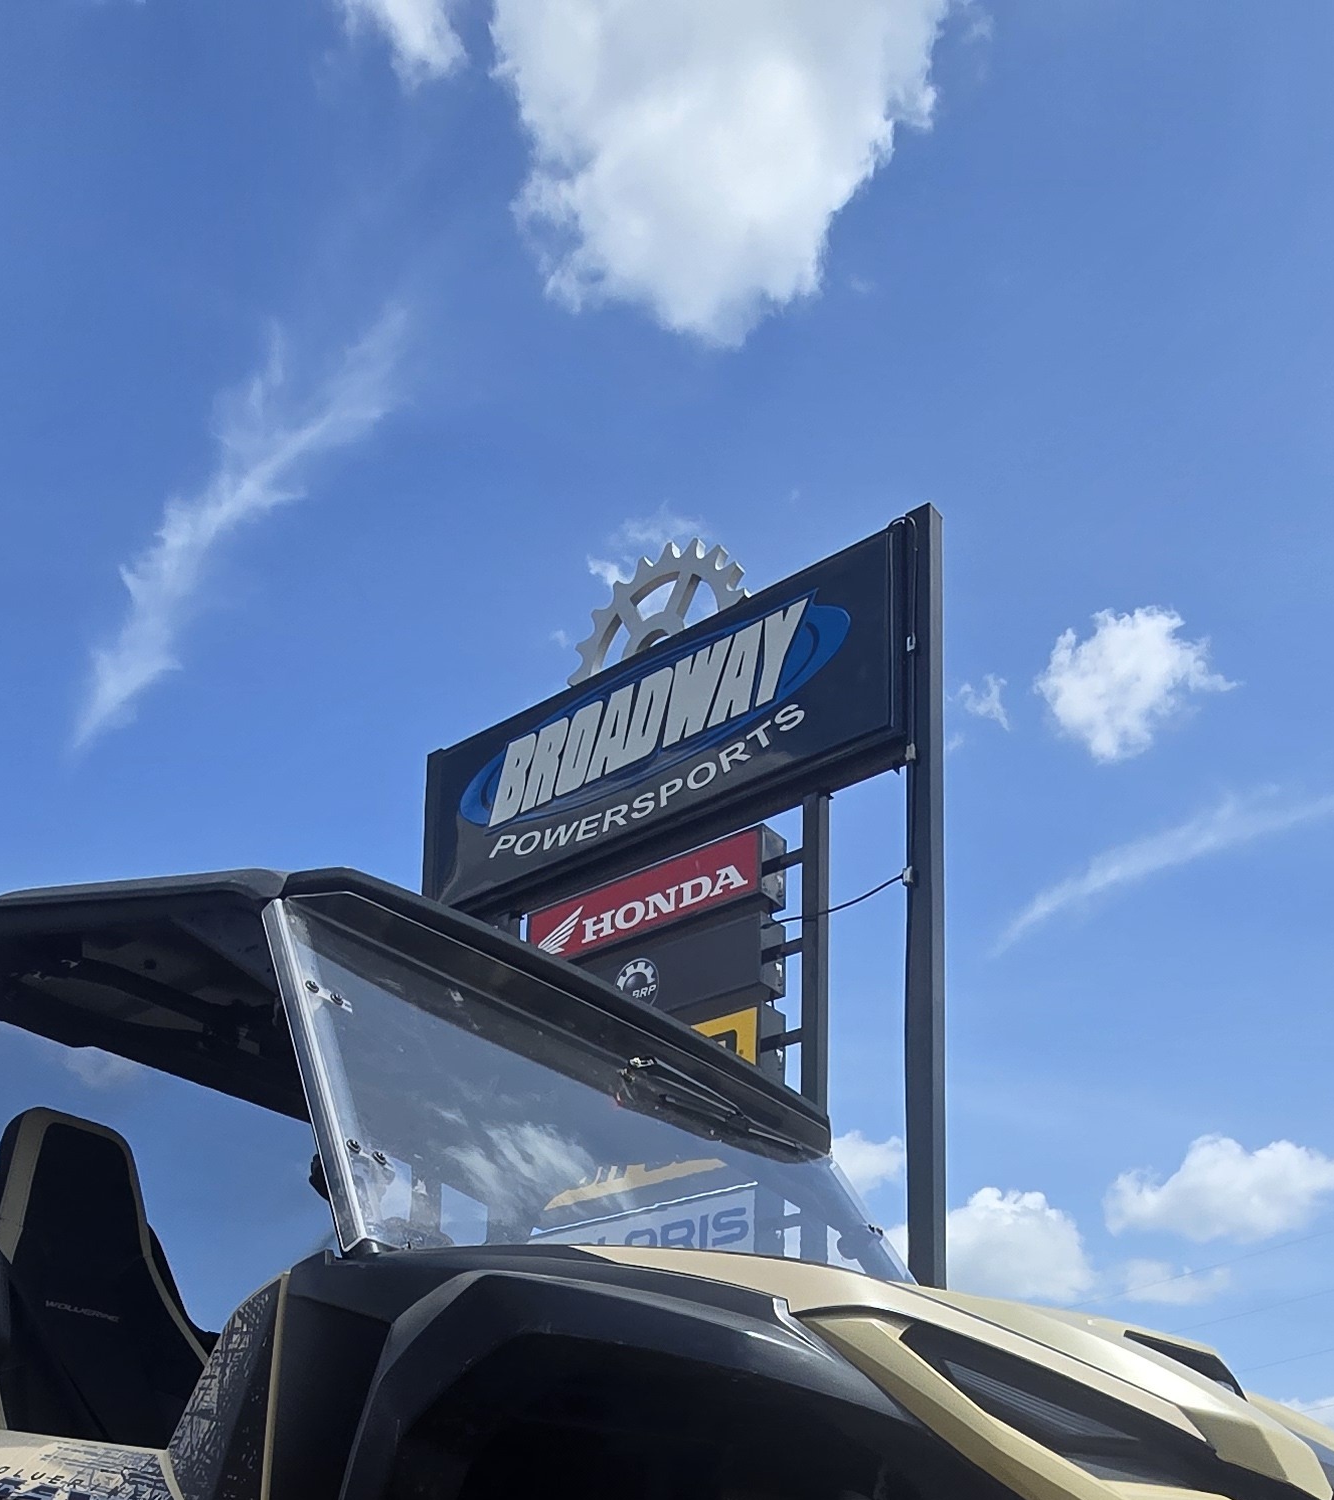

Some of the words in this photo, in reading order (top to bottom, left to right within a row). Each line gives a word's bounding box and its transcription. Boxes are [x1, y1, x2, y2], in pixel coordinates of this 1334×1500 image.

[488, 598, 809, 829] BROADWAY
[489, 703, 805, 859] POWERSPORTS
[581, 865, 749, 944] HONDA
